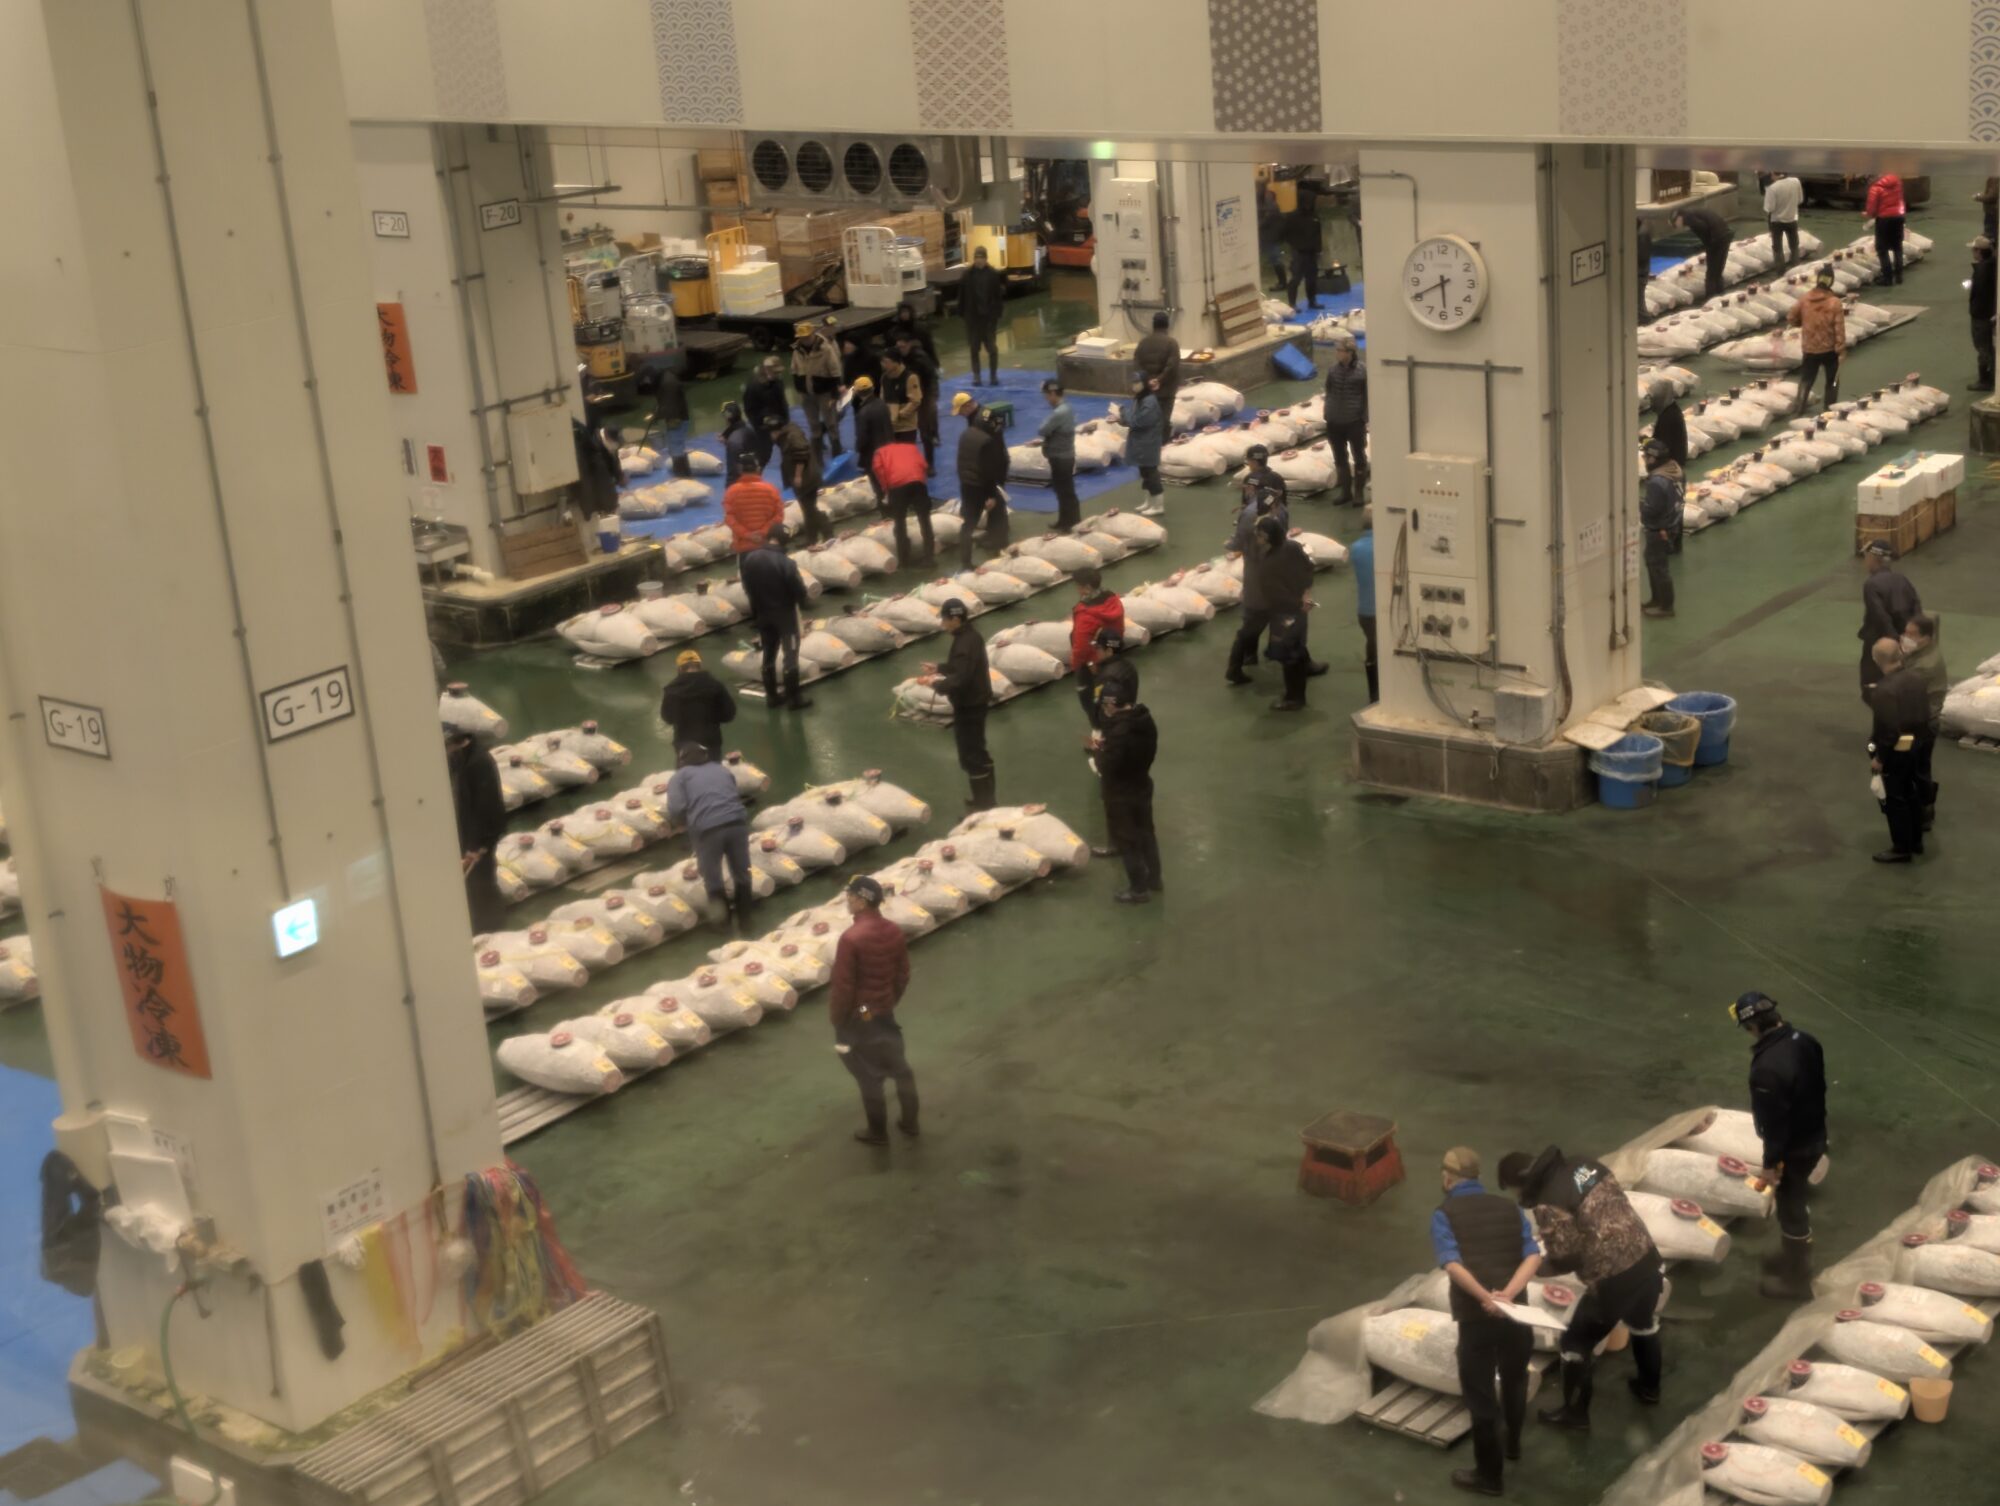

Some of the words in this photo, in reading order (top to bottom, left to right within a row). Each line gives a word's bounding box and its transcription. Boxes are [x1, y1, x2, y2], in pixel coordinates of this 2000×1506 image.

[486, 205, 516, 224] F-20
[378, 215, 405, 232] F-20
[1437, 244, 1449, 255] 12
[1454, 249, 1459, 259] 1
[1423, 250, 1433, 260] 11
[1413, 263, 1425, 272] 10
[1462, 262, 1472, 272] 2
[1576, 250, 1601, 277] F-19
[1411, 276, 1420, 287] 9
[1467, 279, 1476, 289] 3
[1462, 294, 1472, 303] 4
[1425, 305, 1435, 315] 7
[1439, 310, 1448, 320] 6
[1454, 306, 1464, 316] 5
[271, 679, 344, 728] G-19
[49, 709, 102, 746] G-19
[116, 900, 191, 1069] 大物冷凍
